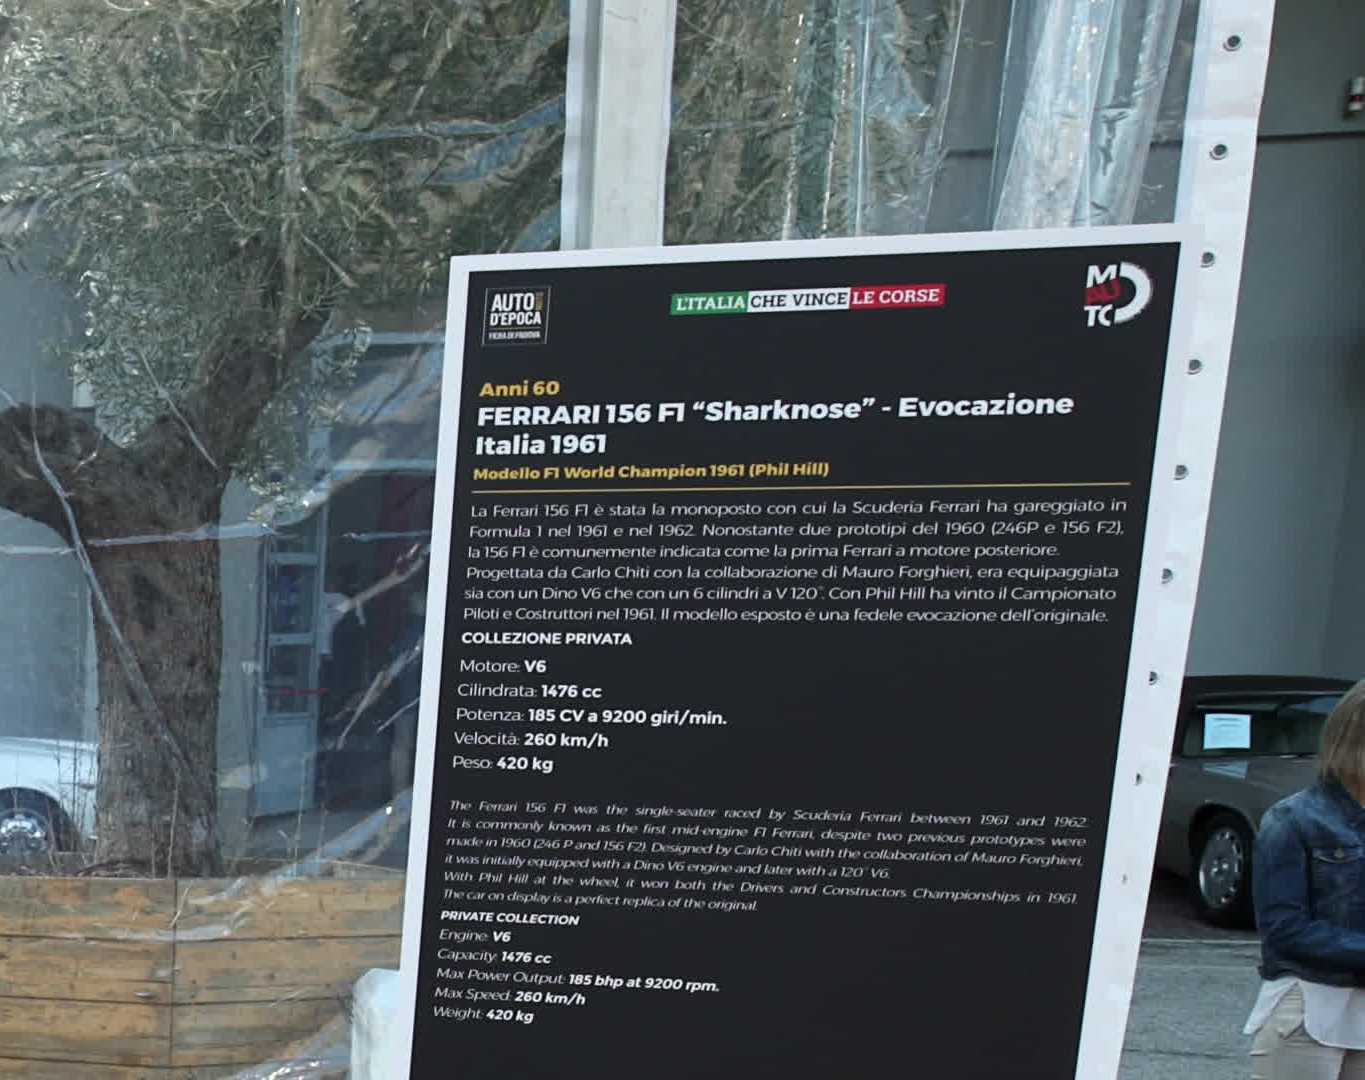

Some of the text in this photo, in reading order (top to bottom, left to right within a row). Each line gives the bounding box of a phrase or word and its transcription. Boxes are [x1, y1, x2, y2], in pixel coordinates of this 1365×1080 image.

[491, 292, 535, 311] AUTO
[676, 288, 940, 311] L'ITALIA CHE VINCE LE CORSE
[489, 311, 542, 326] D'EPOCA
[479, 379, 560, 397] Anni 60
[477, 404, 601, 426] FERRARI
[605, 403, 651, 424] 156
[657, 402, 685, 422] F1
[897, 392, 1074, 417] Evocazione
[475, 432, 607, 455] Italia 1961
[473, 461, 829, 480] Modello F1 World Champion 1961 (Phil Hill)
[471, 505, 487, 518] La
[493, 504, 538, 517] Ferrari
[543, 504, 569, 517] 156
[574, 503, 589, 517] F1
[609, 504, 646, 516] stata
[652, 503, 665, 516] la
[670, 503, 762, 518] monoposto
[766, 504, 797, 515] con
[801, 501, 826, 514] cui
[832, 500, 846, 514] la
[852, 500, 923, 514] Scuderia
[929, 500, 980, 513] Ferrari
[986, 498, 1008, 512] ha
[1013, 499, 1105, 515] gareggiato
[1110, 498, 1127, 511] in
[469, 524, 531, 538] Formula
[537, 524, 542, 537] 1
[548, 524, 571, 537] nel
[577, 524, 608, 537] 1961
[613, 527, 624, 537] e
[629, 523, 653, 536] nel
[702, 523, 794, 536] Nonostante
[798, 522, 831, 536] due
[837, 522, 906, 539] prototipi
[911, 521, 938, 535] del
[946, 521, 985, 535] 1960
[991, 521, 1039, 536] (246P
[1044, 524, 1056, 534] e
[1062, 520, 1090, 534] 156
[1096, 520, 1124, 535] F2),
[461, 631, 633, 645] COLLEZIONE PRIVATA
[460, 659, 547, 673] Motore: V6
[457, 683, 602, 698] Cilindrata: 1476 cc
[456, 707, 727, 727] Potenza: 185 CV a 9200 giri/min.
[523, 732, 557, 746] 260
[559, 732, 609, 749] km/h
[452, 755, 554, 774] Peso: 420 kg
[440, 910, 580, 925] PRIVATE COLLECTION
[492, 930, 511, 942] V6
[501, 950, 532, 963] 1476
[533, 954, 552, 964] cc
[436, 967, 464, 979] Max
[467, 968, 510, 981] Power
[569, 973, 593, 986] 185
[594, 974, 624, 990] bhp
[625, 976, 642, 988] at
[644, 977, 683, 990] 9200
[685, 981, 719, 993] rpm.
[434, 986, 463, 998] Max
[513, 990, 543, 1003] 260
[544, 991, 586, 1006] km/h
[485, 1008, 514, 1021] 420
[515, 1009, 534, 1024] kg
